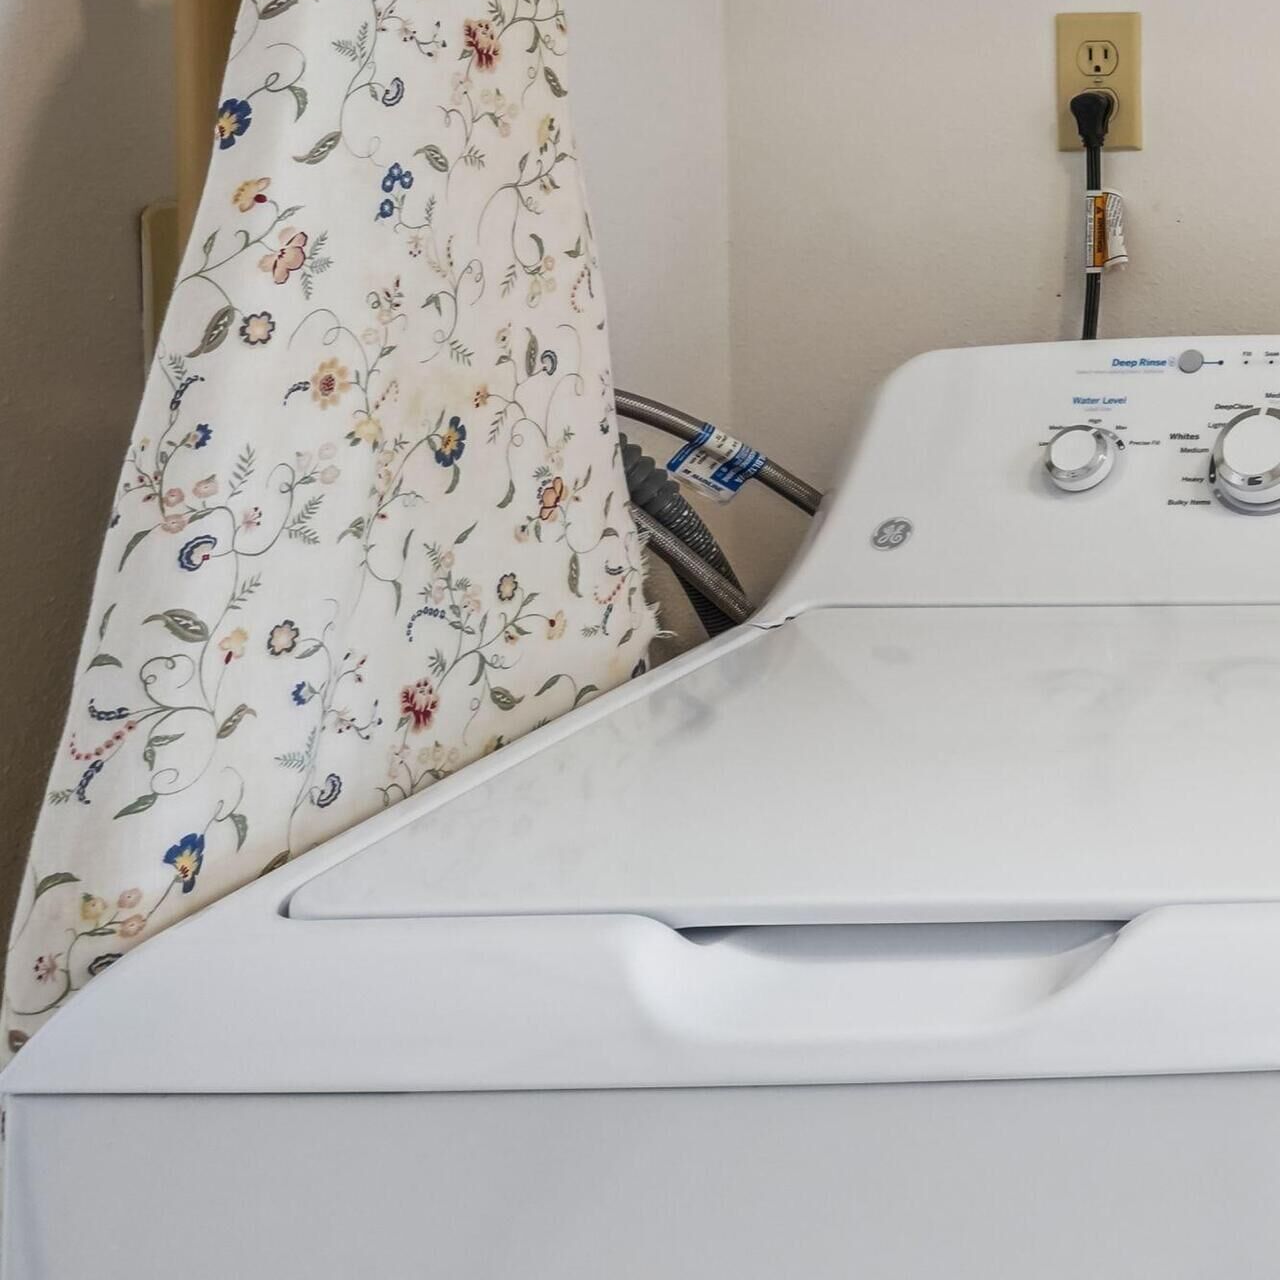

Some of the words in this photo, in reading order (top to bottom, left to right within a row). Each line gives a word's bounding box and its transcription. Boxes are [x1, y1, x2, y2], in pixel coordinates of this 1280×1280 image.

[1112, 358, 1137, 368] Deep
[1139, 358, 1167, 367] Rinse
[1072, 396, 1100, 405] Water
[1102, 396, 1128, 405] Level
[1169, 432, 1200, 440] Whites
